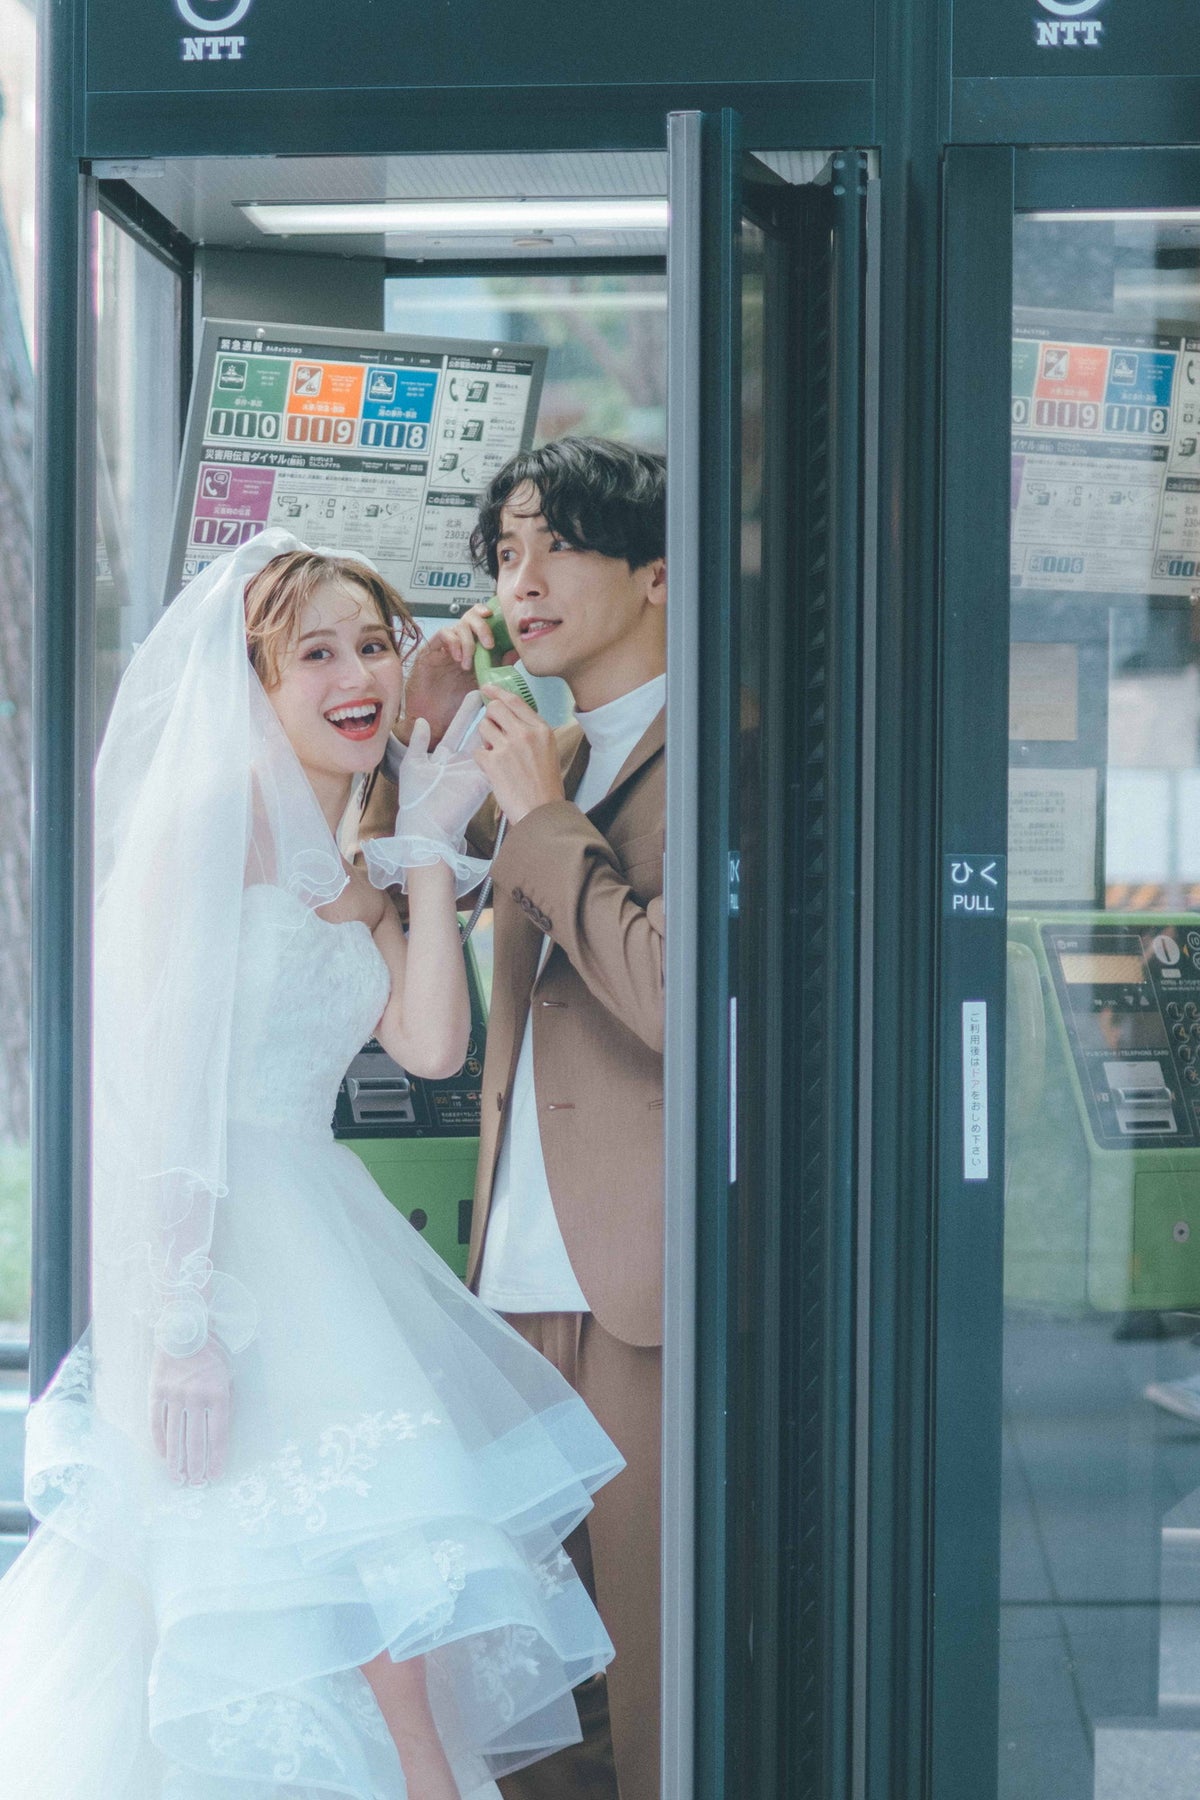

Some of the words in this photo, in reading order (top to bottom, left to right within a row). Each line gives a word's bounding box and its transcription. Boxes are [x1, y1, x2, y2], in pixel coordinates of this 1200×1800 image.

[1036, 21, 1102, 46] NTT
[183, 36, 245, 60] NTT
[218, 412, 276, 438] 110
[1041, 402, 1097, 428] 119
[1110, 405, 1167, 433] 118
[294, 417, 352, 443] 119
[368, 422, 424, 448] 118
[951, 861, 998, 885] ひく
[953, 894, 995, 911] PULL
[970, 1012, 982, 1167] ご利用後はドアをおしめ下さい
